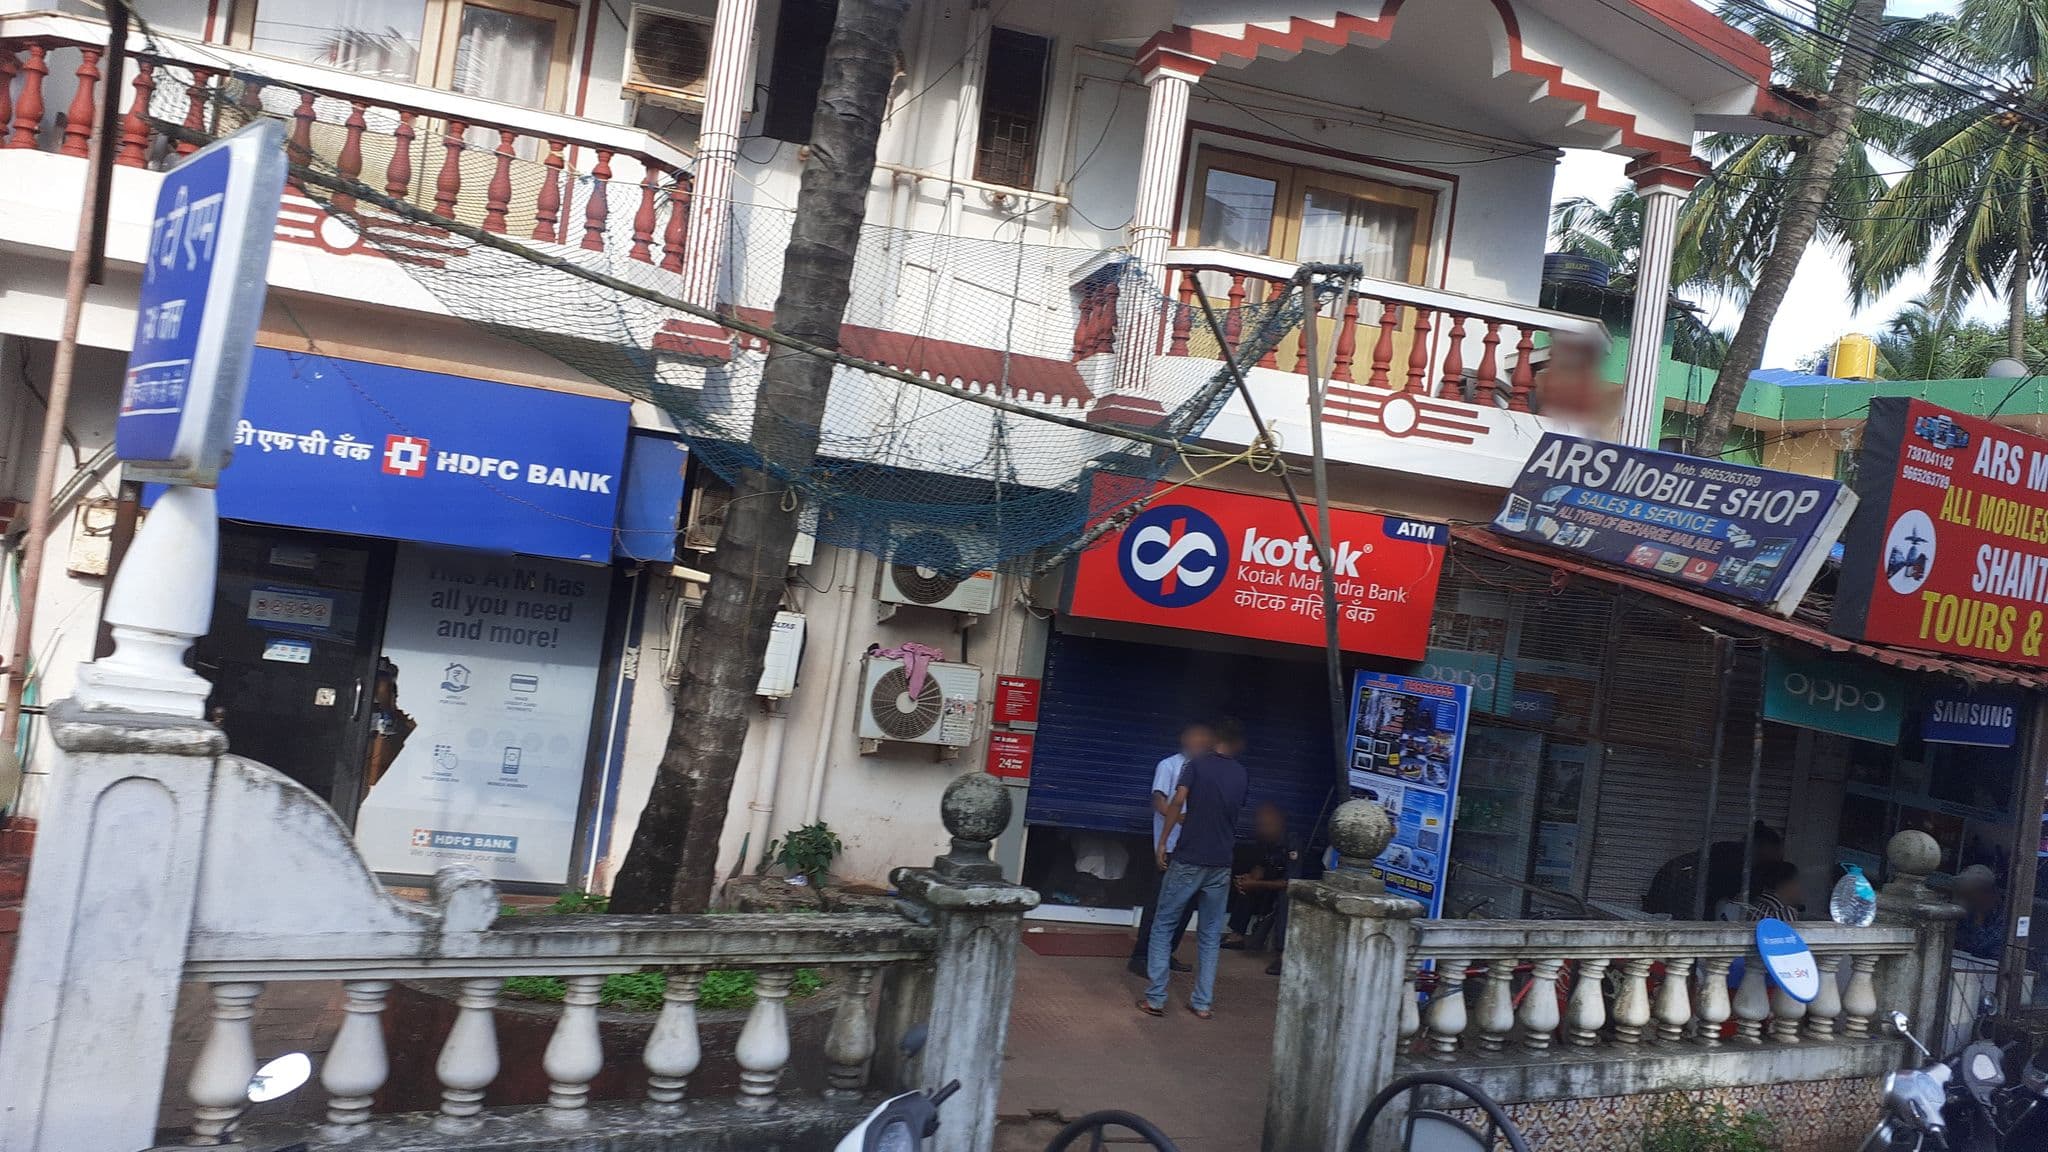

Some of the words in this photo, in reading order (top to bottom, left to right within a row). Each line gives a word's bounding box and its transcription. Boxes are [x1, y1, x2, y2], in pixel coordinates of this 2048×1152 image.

[435, 450, 520, 482] HDFC
[526, 463, 613, 494] BANK
[1673, 463, 1696, 476] Mob.
[1972, 436, 2024, 485] ARS
[1527, 440, 1618, 488] ARS
[1611, 457, 1722, 510] MOBILE
[1720, 489, 1820, 526] SHOP
[1396, 521, 1436, 540] ATM
[1578, 491, 1628, 514] SALES
[1630, 503, 1642, 517] &
[1644, 506, 1718, 533] SERVICE
[1939, 486, 1972, 526] ALL
[1976, 494, 2048, 544] MOBILES
[1240, 526, 1362, 578] kotak
[542, 571, 585, 598] has
[1237, 565, 1284, 587] Kotak
[1289, 571, 1364, 598] Mahndra
[1368, 583, 1408, 605] Bank
[1972, 544, 2048, 604] SHANT
[430, 588, 460, 610] all
[463, 594, 508, 617] you
[515, 599, 573, 623] need
[1234, 586, 1289, 612] कोटक
[1346, 600, 1378, 624] बँक
[1919, 590, 2016, 653] TOURS
[2021, 610, 2043, 656] &
[436, 618, 483, 641] and
[489, 624, 560, 649] more!
[1933, 700, 2013, 728] SAMSUNG
[434, 834, 473, 847] HDFC
[474, 837, 513, 850] BANK
